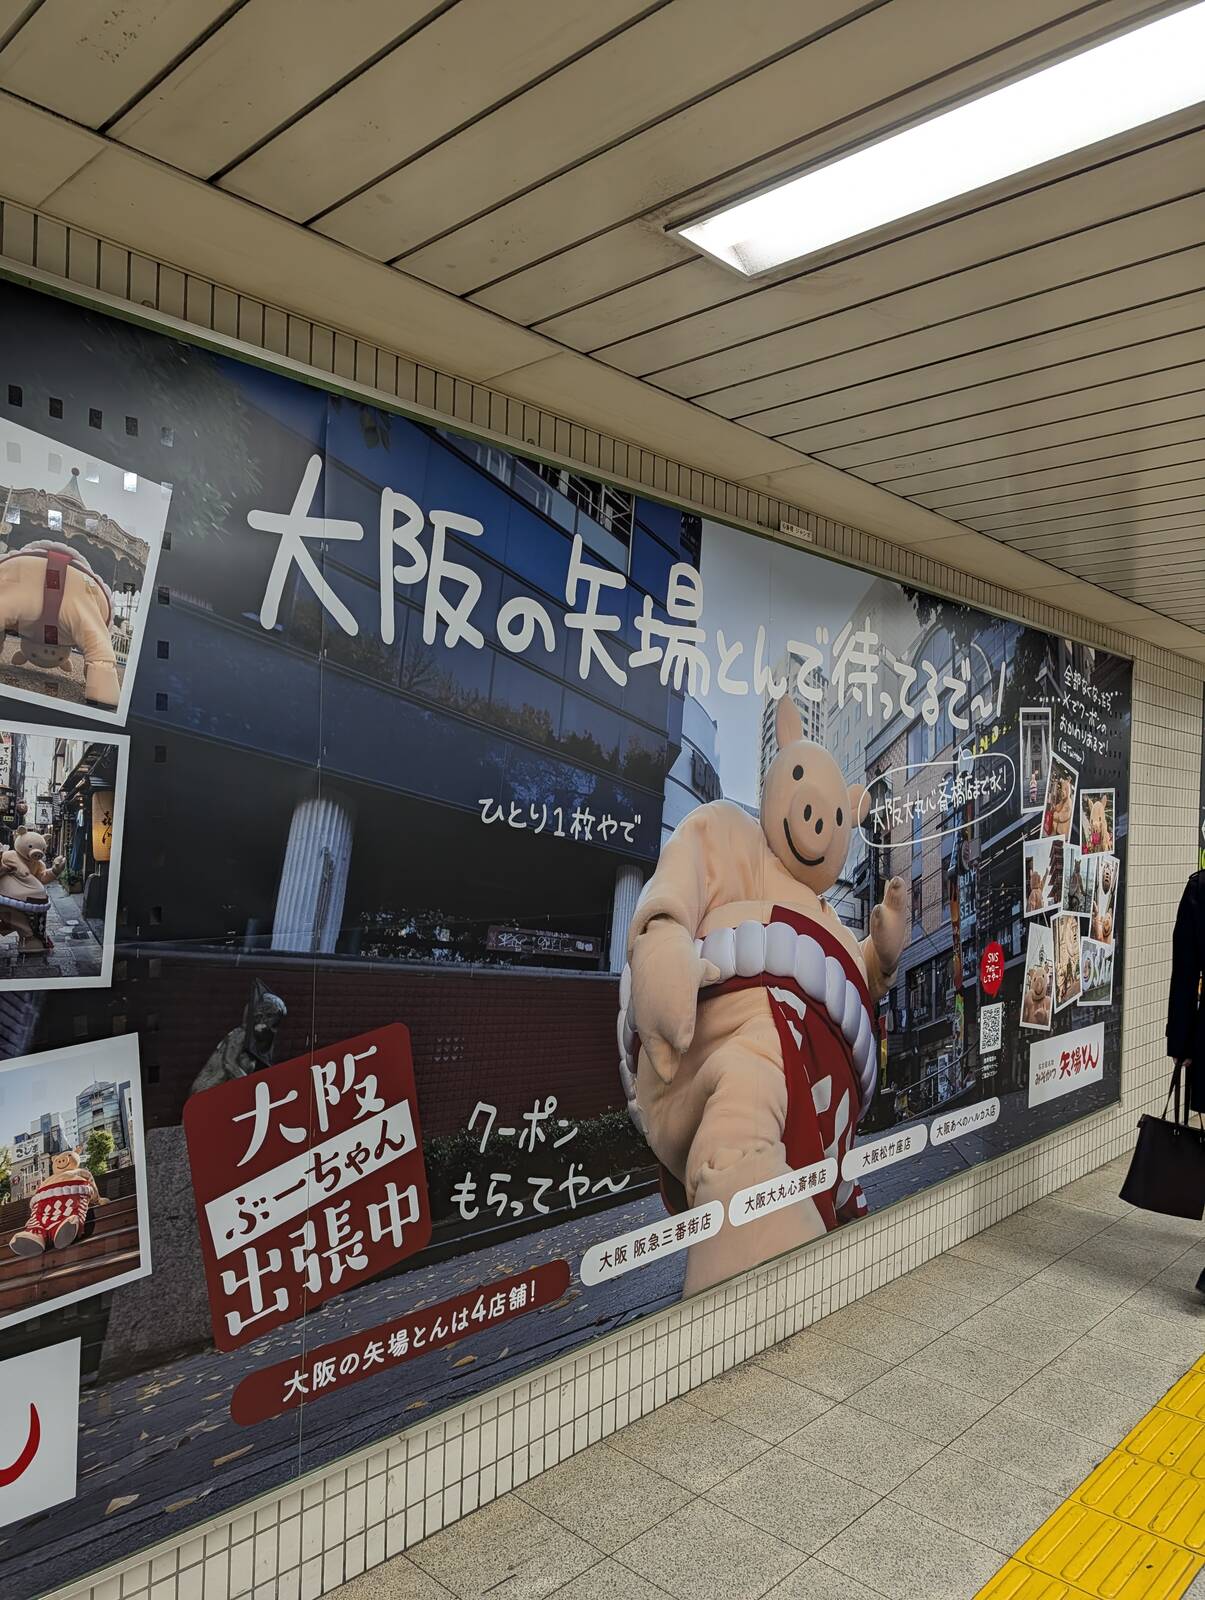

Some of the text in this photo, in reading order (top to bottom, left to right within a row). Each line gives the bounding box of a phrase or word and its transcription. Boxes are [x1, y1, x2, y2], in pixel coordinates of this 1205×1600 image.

[478, 798, 642, 843] ひとり1枚やで
[987, 952, 999, 963] SNS
[1058, 1040, 1100, 1080] 矢場とん
[232, 1045, 386, 1167] 大阪
[467, 1095, 578, 1154] クーポン
[935, 1105, 997, 1139] 大阪あべのハルカス店
[862, 1136, 912, 1168] 大阪松竹座店
[225, 1119, 406, 1241] ぶーちゃん
[744, 1168, 828, 1215] 大阪大丸心斎橋店
[219, 1181, 420, 1337] 出張中
[598, 1212, 713, 1273] 大阪 阪急三番街店
[281, 1279, 537, 1403] 大阪の矢場とんは4店舗!
